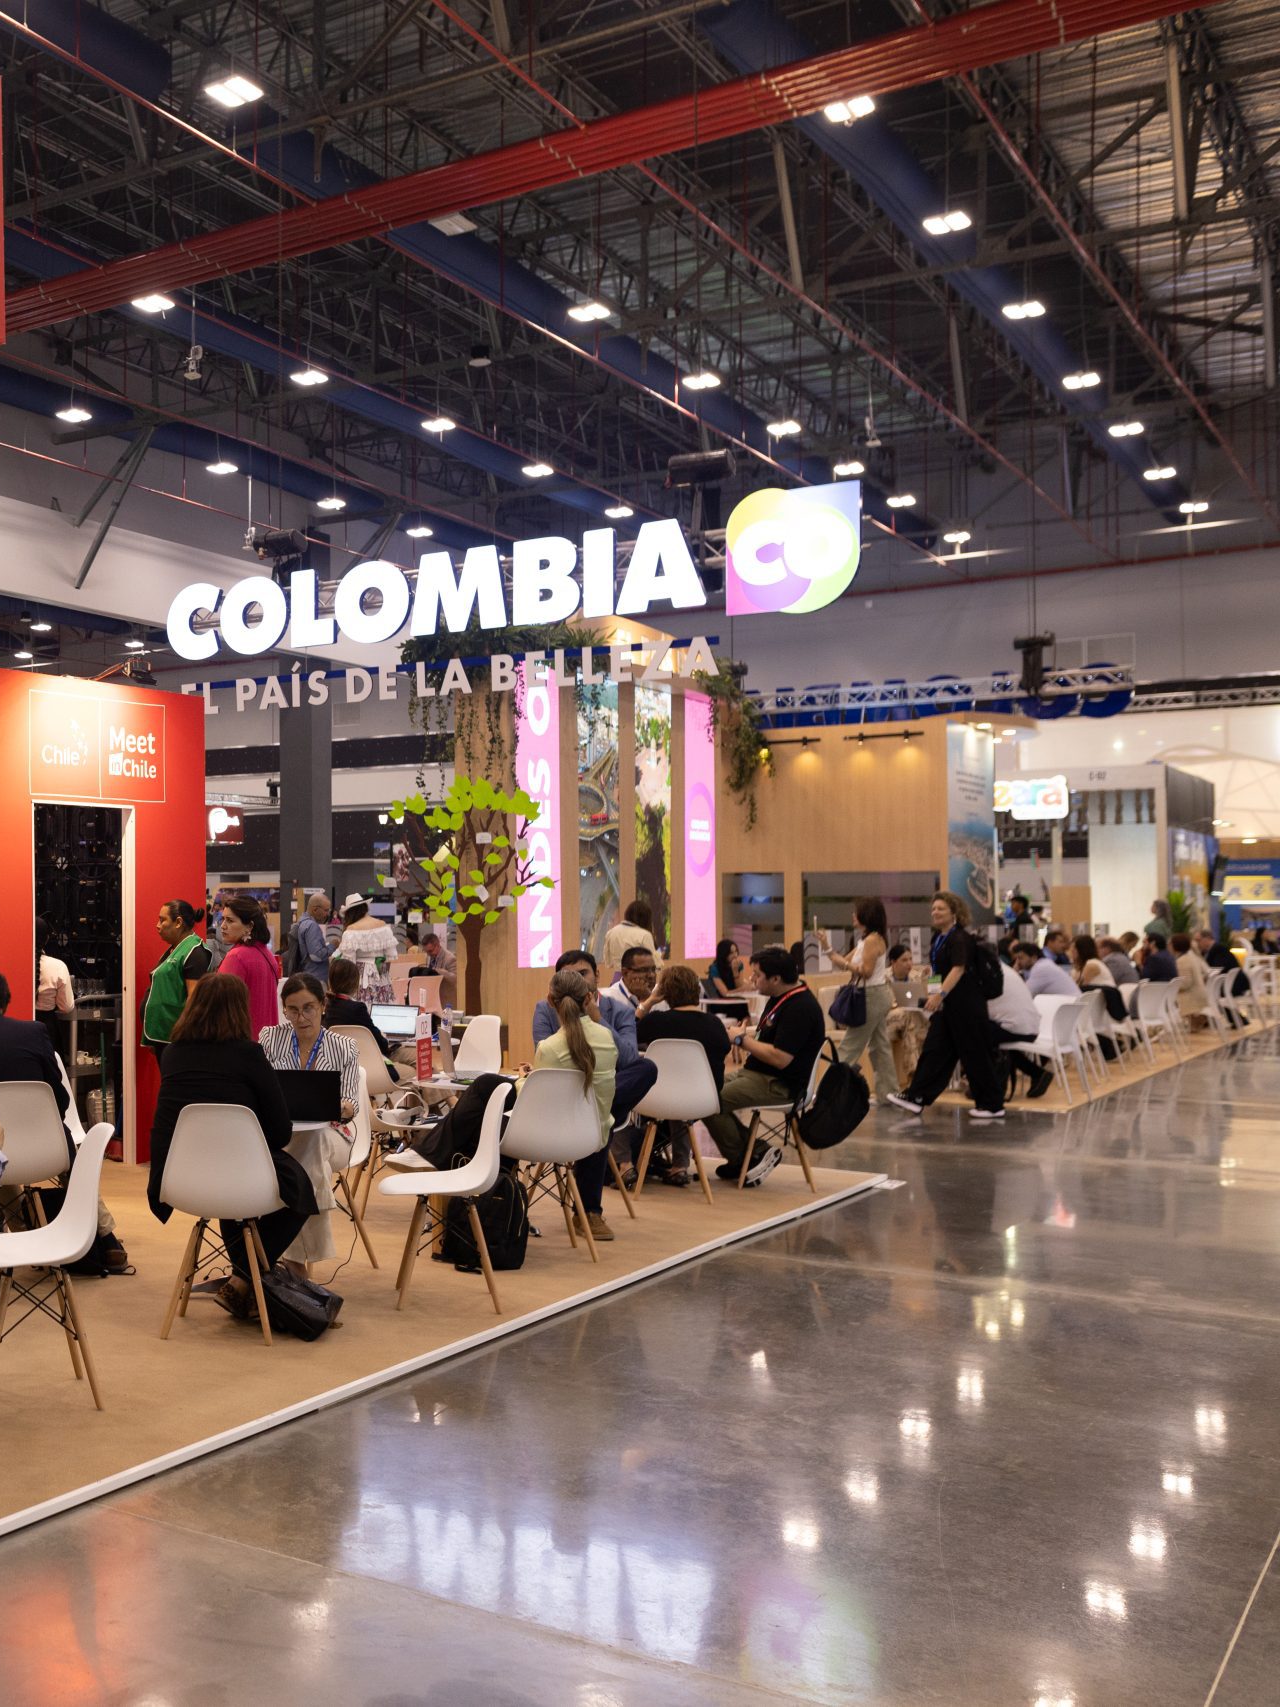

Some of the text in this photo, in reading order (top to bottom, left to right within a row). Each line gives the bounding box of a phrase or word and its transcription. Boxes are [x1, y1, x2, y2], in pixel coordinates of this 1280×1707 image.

[166, 518, 708, 661] COLOMBIA
[236, 670, 329, 712] PAÍS
[346, 668, 398, 704] DE
[416, 660, 473, 698] LA
[491, 637, 720, 692] BELLEZA
[41, 744, 80, 766] Chile
[109, 725, 156, 755] Meet
[527, 758, 553, 969] ANDES
[420, 1020, 428, 1035] 02
